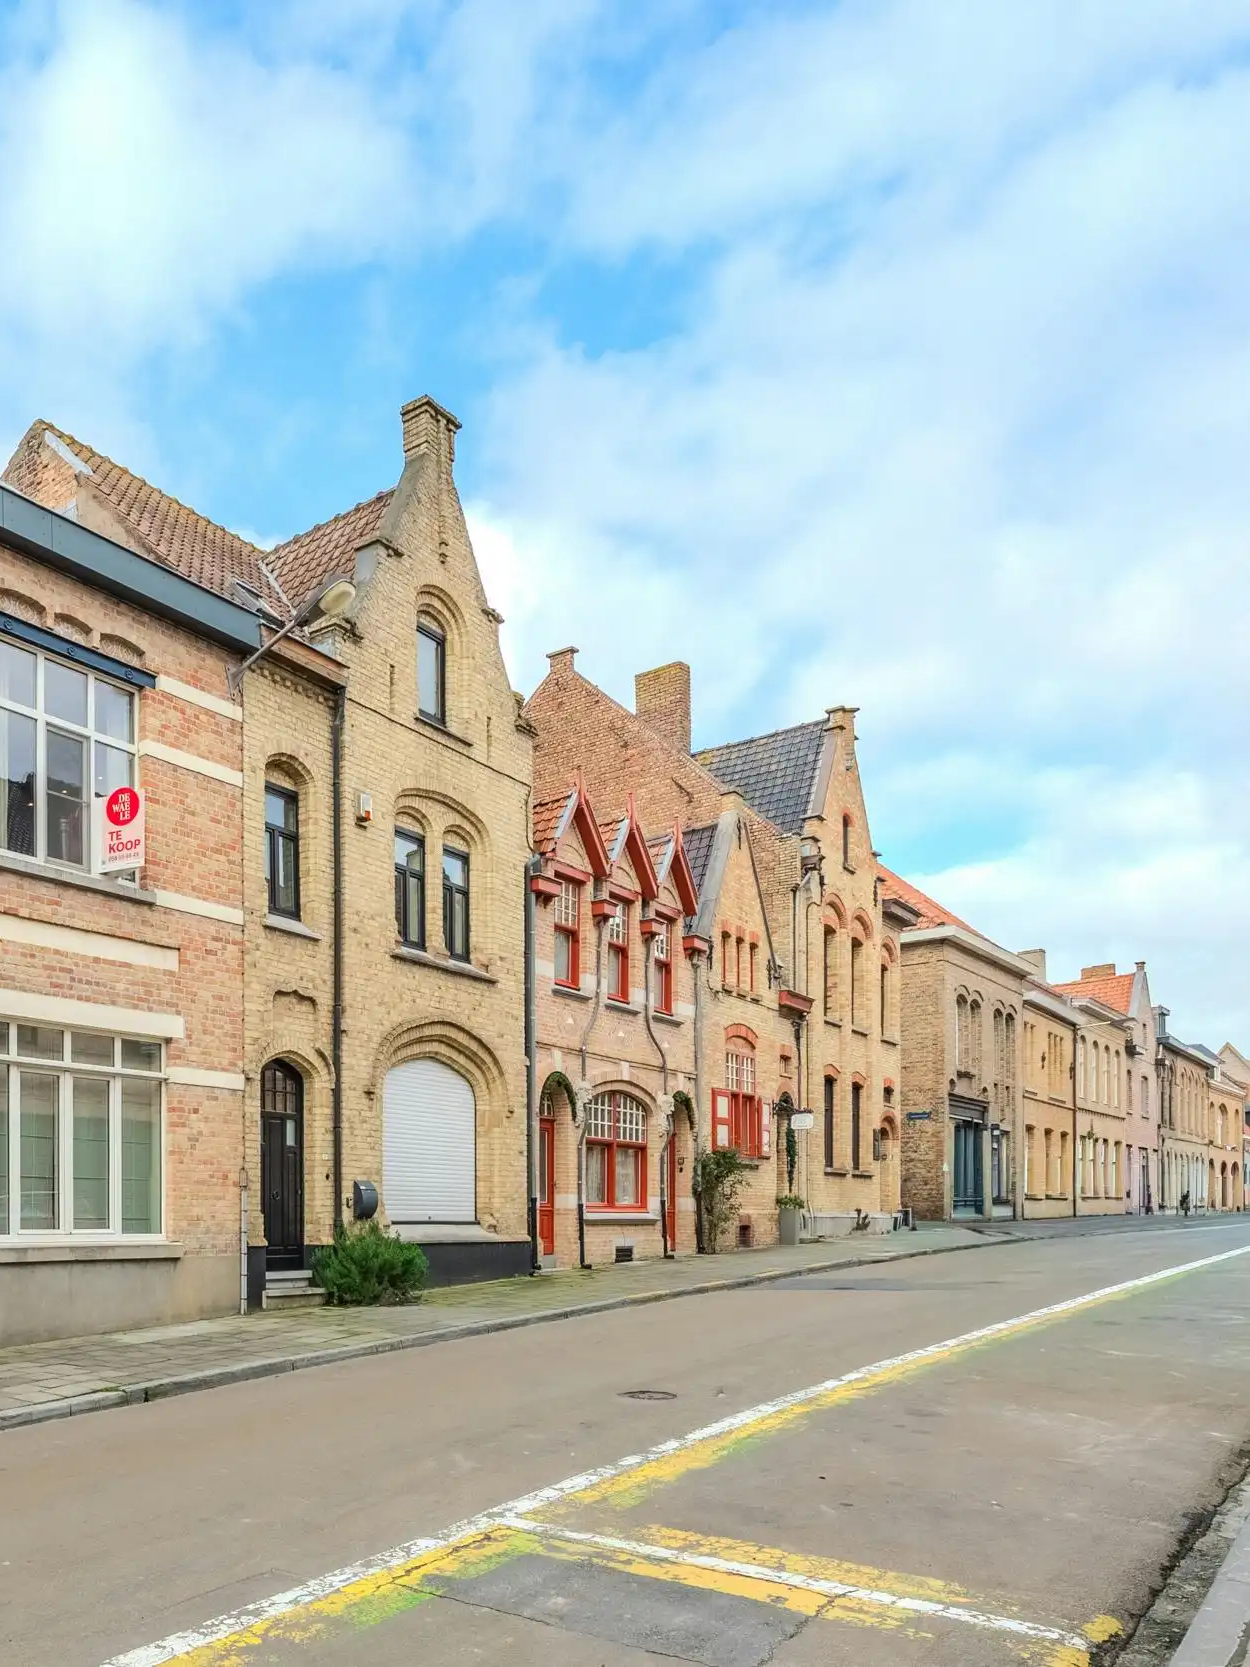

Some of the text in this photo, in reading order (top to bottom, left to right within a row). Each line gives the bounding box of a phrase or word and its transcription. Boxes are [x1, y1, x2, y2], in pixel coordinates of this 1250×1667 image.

[118, 793, 130, 802] DE
[112, 802, 130, 813] WAE
[120, 811, 130, 821] LE
[108, 830, 122, 841] TE
[108, 839, 140, 854] KOOP
